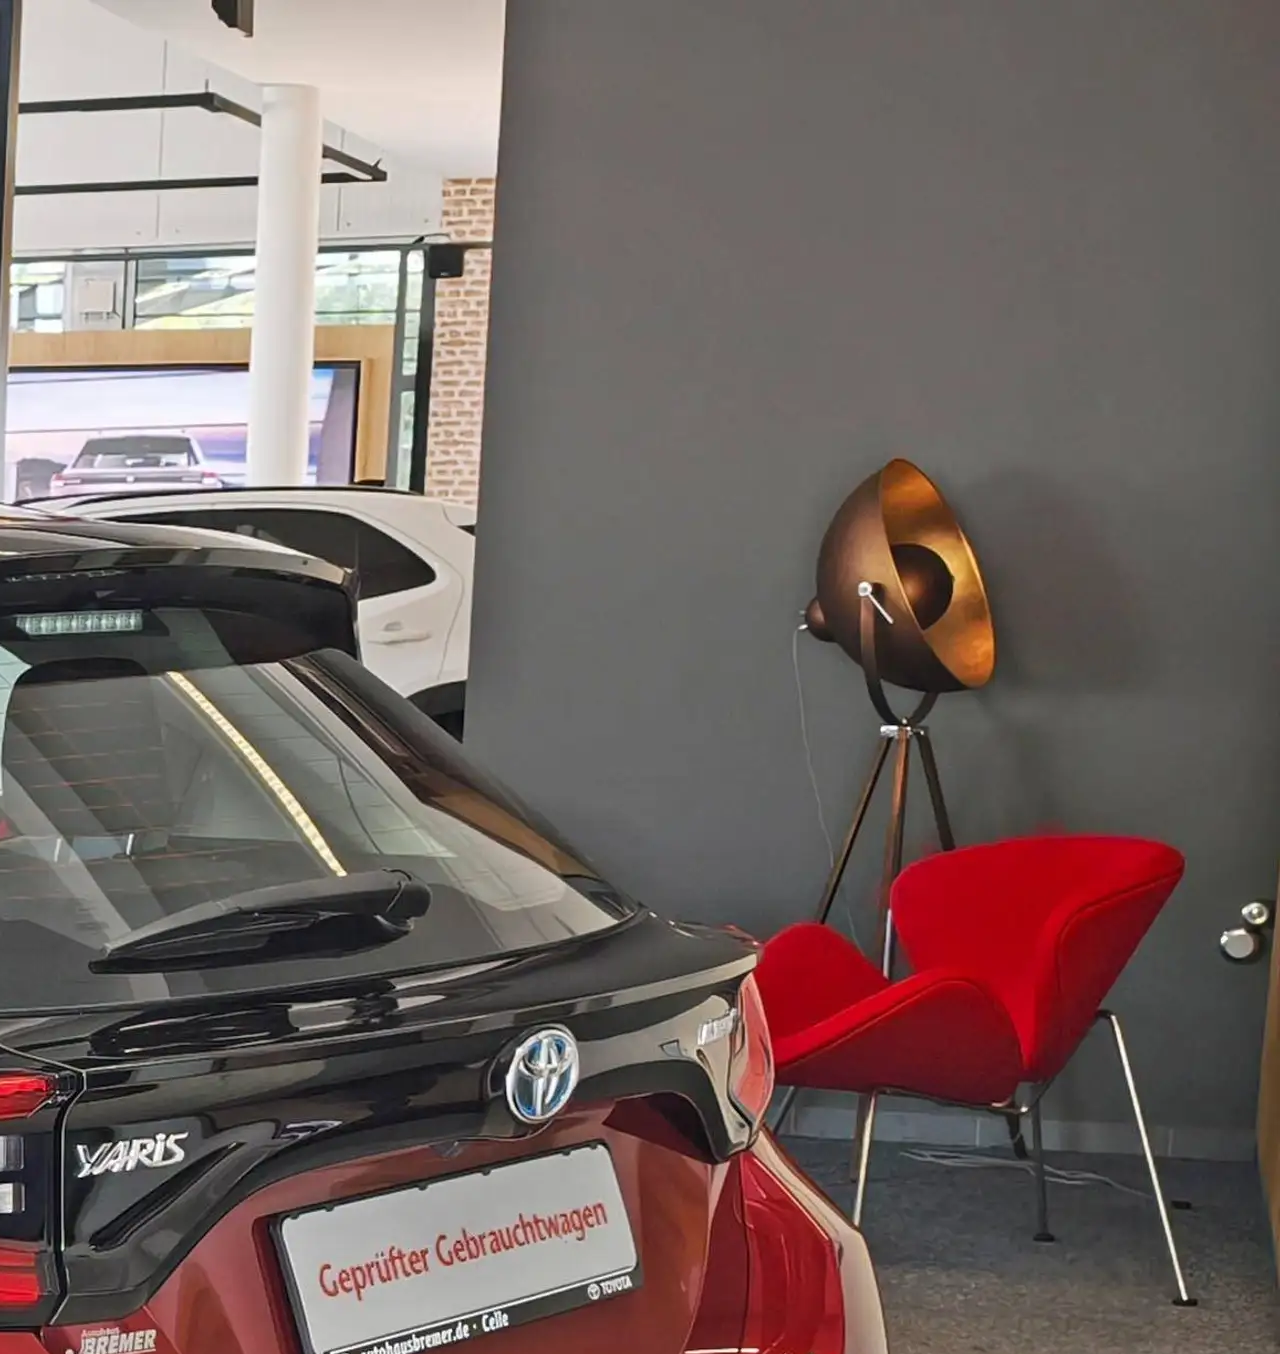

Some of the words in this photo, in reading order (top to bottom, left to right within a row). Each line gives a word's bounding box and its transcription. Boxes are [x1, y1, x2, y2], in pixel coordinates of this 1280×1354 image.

[318, 1246, 430, 1302] Geprüfter
[435, 1202, 609, 1267] Gebrauchtwagen
[481, 1310, 510, 1333] Celle
